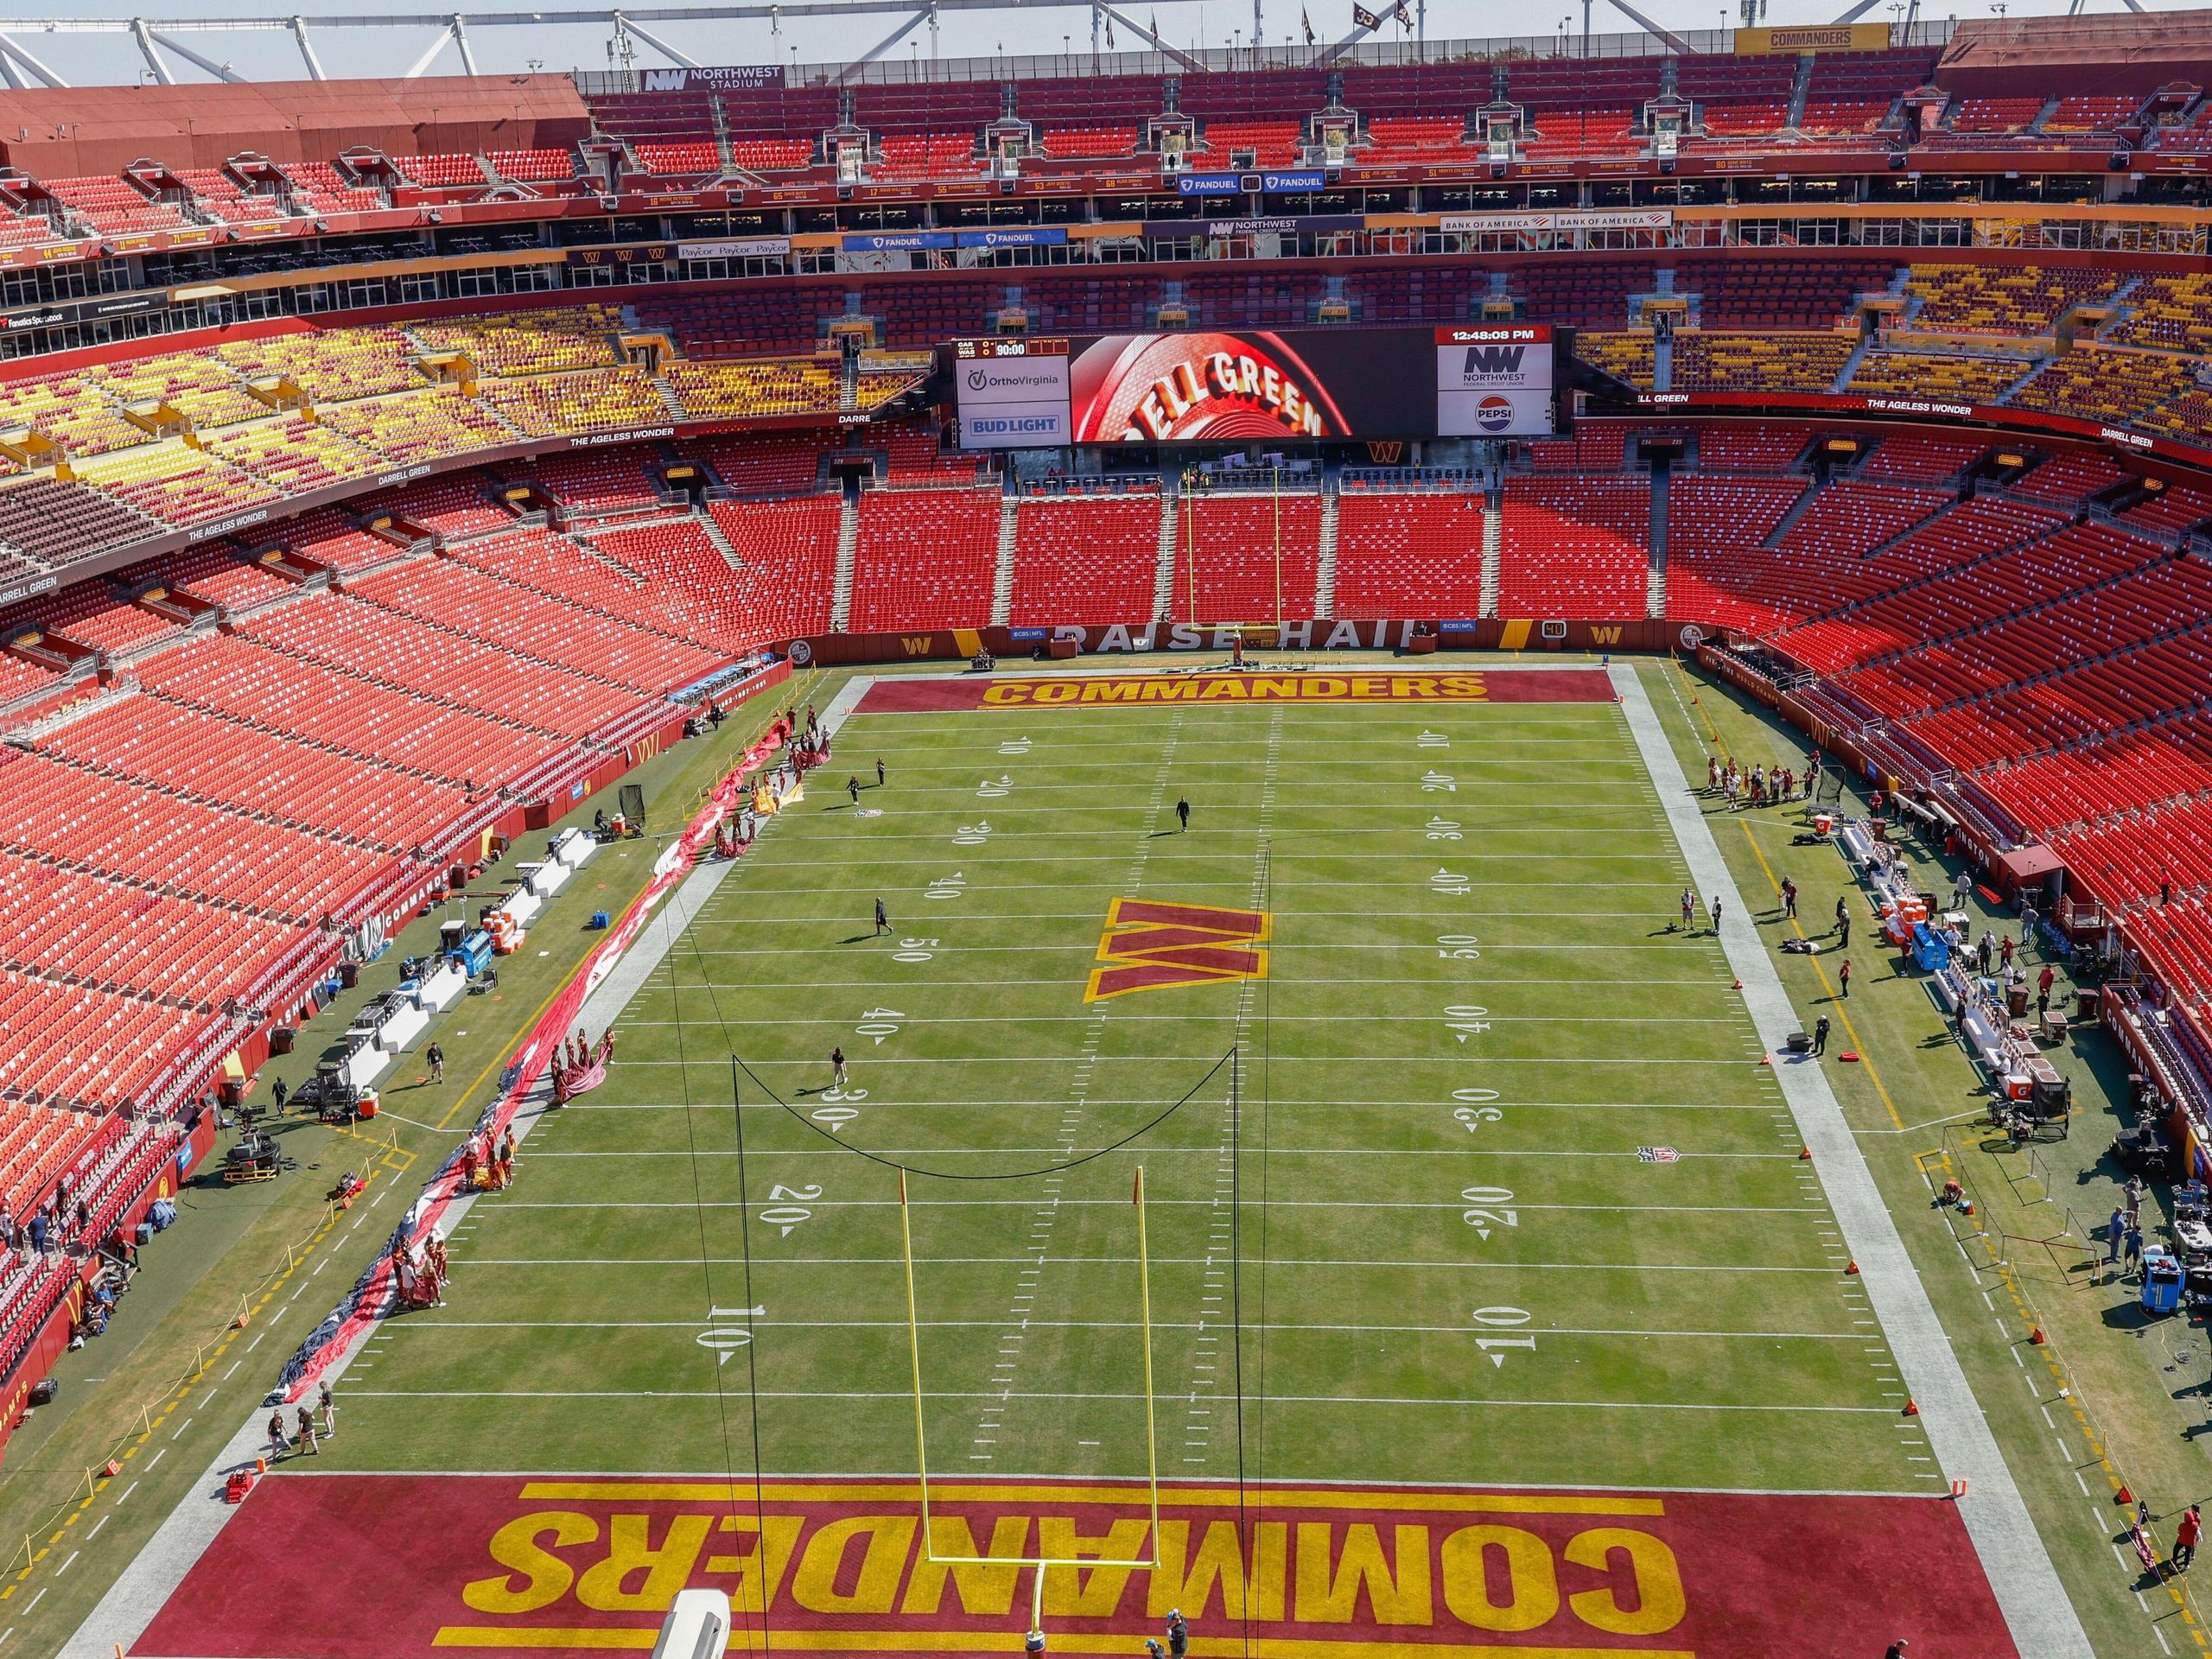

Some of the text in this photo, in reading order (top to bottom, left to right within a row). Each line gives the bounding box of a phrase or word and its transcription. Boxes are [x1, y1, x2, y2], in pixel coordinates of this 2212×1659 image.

[1771, 30, 1852, 47] COMMANDERS
[691, 67, 780, 80] NORTHWEST
[710, 79, 763, 89] STADIUM
[1281, 177, 1322, 187] FANDUEL
[1360, 171, 1370, 180] 66
[1035, 181, 1044, 190] 53
[1195, 180, 1236, 189] FANDUEL
[650, 197, 658, 206] 16
[773, 192, 783, 200] 65
[1210, 219, 1297, 234] NW NORTHWEST
[1446, 221, 1471, 230] BANK
[885, 238, 922, 247] FANDUEL
[998, 233, 1035, 242] FANDUEL
[682, 244, 788, 257] Paycor Paycor Paycor
[9, 316, 31, 328] Fanatics
[1452, 330, 1535, 340] 12:48:08 PM
[997, 344, 1025, 356] 90:00
[1464, 346, 1526, 373] NW
[989, 373, 1058, 387] OrthoVirginia
[1464, 373, 1526, 382] NORTHWEST
[1654, 394, 1688, 403] GREEN
[1867, 399, 1972, 415] THE AGELESS WONDER
[1478, 410, 1511, 418] PEPSI
[973, 419, 1056, 434] BUD LIGHT
[570, 427, 674, 447] THE AGELESS WONDER
[2101, 429, 2153, 448] DARRELL GREEN
[378, 465, 430, 486] DARRELL GREEN
[188, 510, 268, 542] THE AGELESS WONDER
[29, 575, 57, 593] GREEN
[1054, 622, 1245, 652] RAISE
[1545, 624, 1562, 636] 40
[983, 676, 1489, 704] COMMANDERS
[976, 779, 1014, 797] 20
[1421, 774, 1457, 791] 20
[952, 826, 992, 845] 30
[1426, 822, 1462, 840] 30
[924, 878, 966, 899] 40
[1431, 874, 1471, 896] 40
[892, 938, 940, 962] 50
[1436, 935, 1480, 961] 50
[855, 1007, 906, 1035] 40
[1443, 1006, 1491, 1033] 40
[2018, 1087, 2027, 1096] G
[811, 1089, 868, 1121] 30
[1452, 1089, 1503, 1122] 30
[760, 1184, 823, 1223] 20
[1461, 1187, 1519, 1227] 20
[696, 1305, 766, 1348] 10
[1472, 1306, 1536, 1351] 10
[462, 1510, 1687, 1635] COMMANDERS
